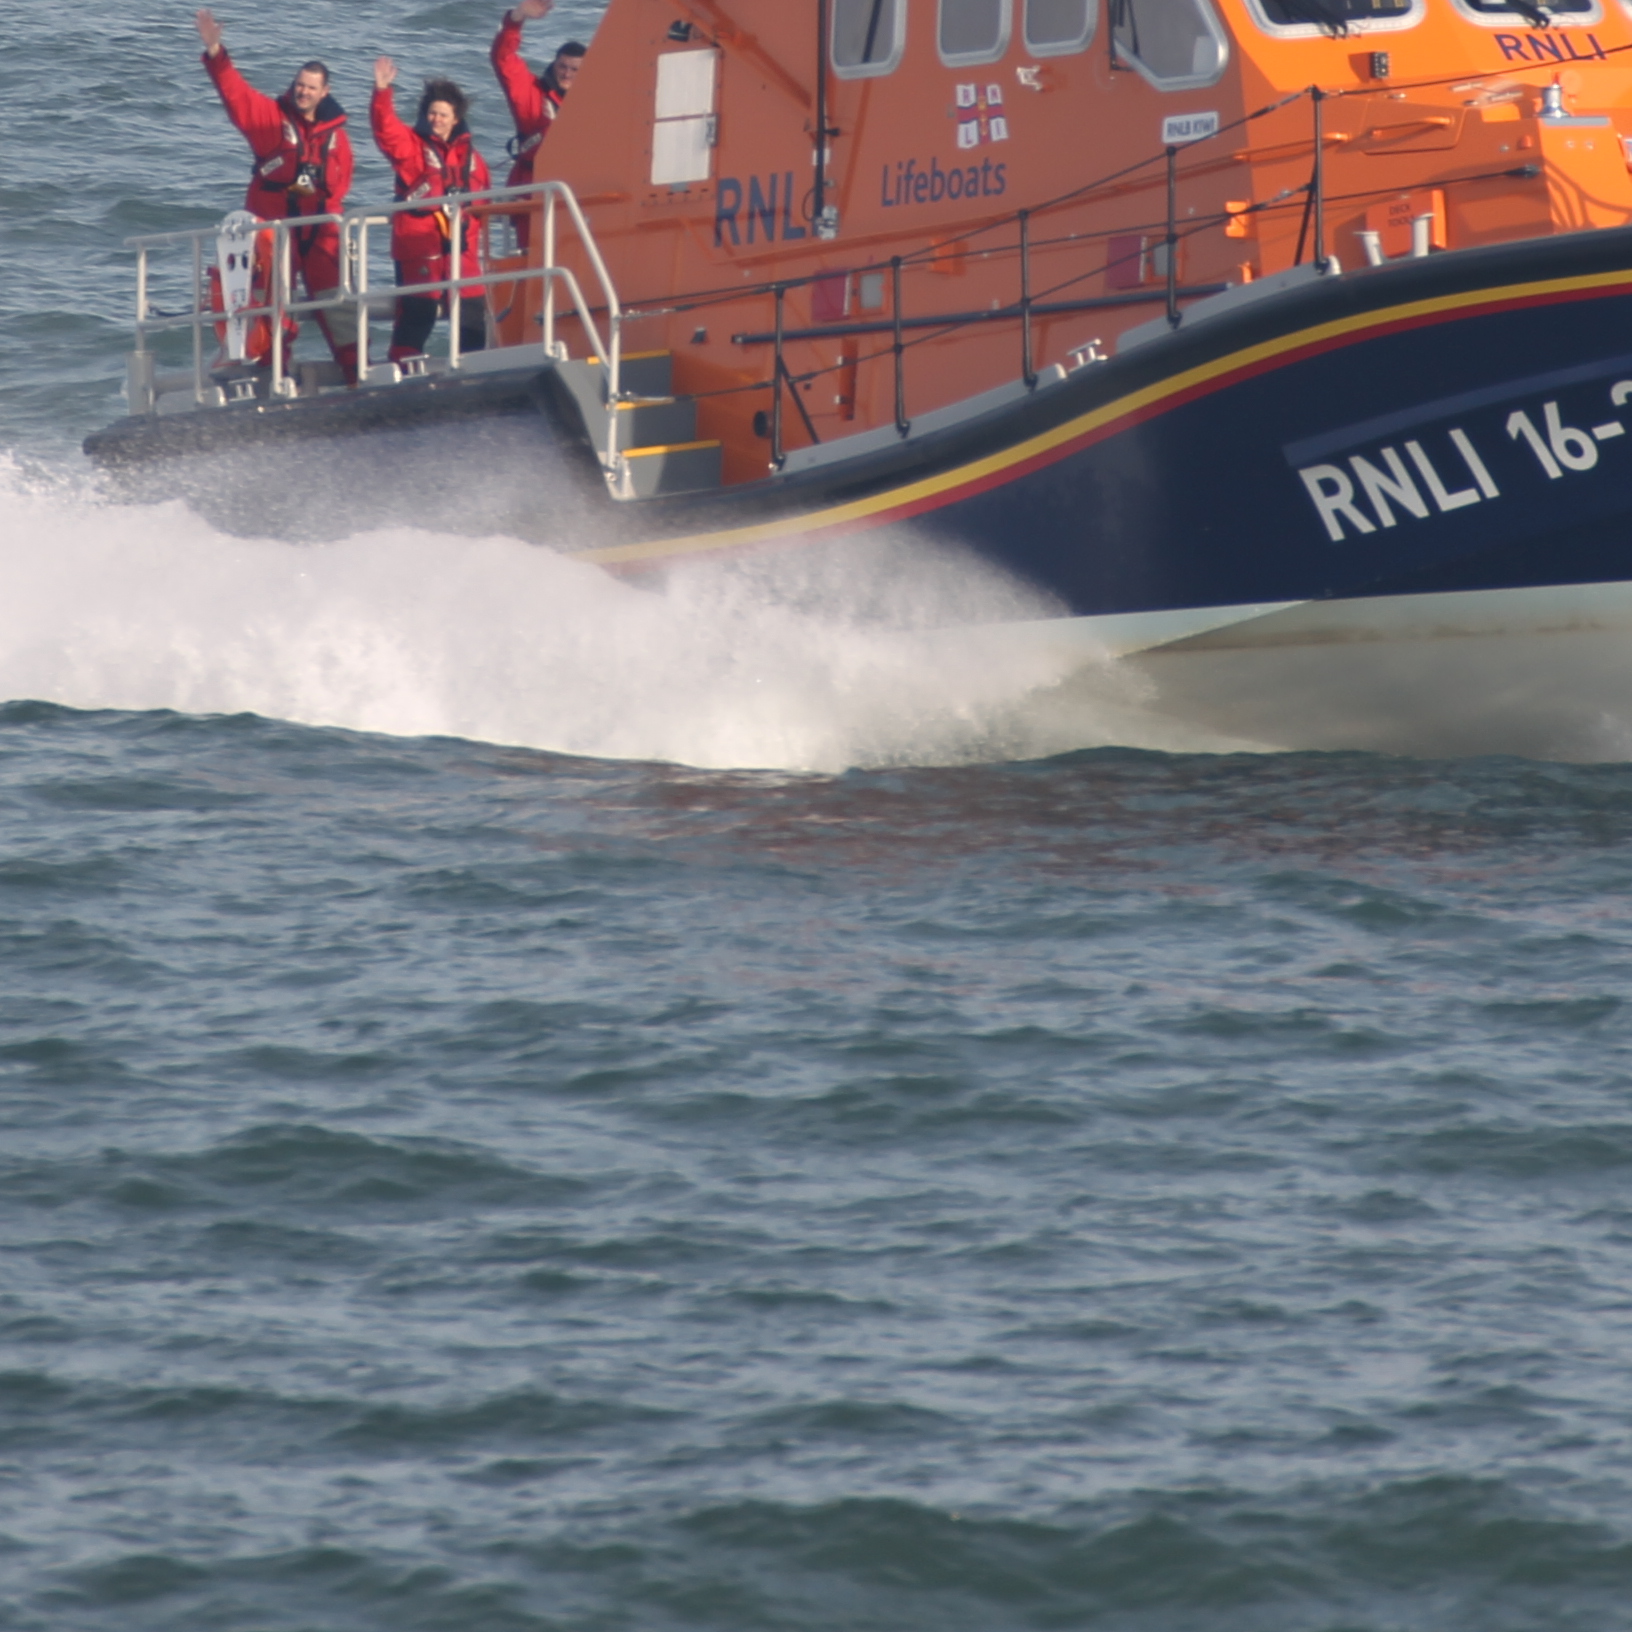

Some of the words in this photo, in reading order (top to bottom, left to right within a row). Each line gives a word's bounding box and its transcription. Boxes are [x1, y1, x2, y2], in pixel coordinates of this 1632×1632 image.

[1494, 33, 1607, 61] RNLI
[881, 156, 1006, 206] Lifeboats
[1299, 429, 1500, 541] RNLI
